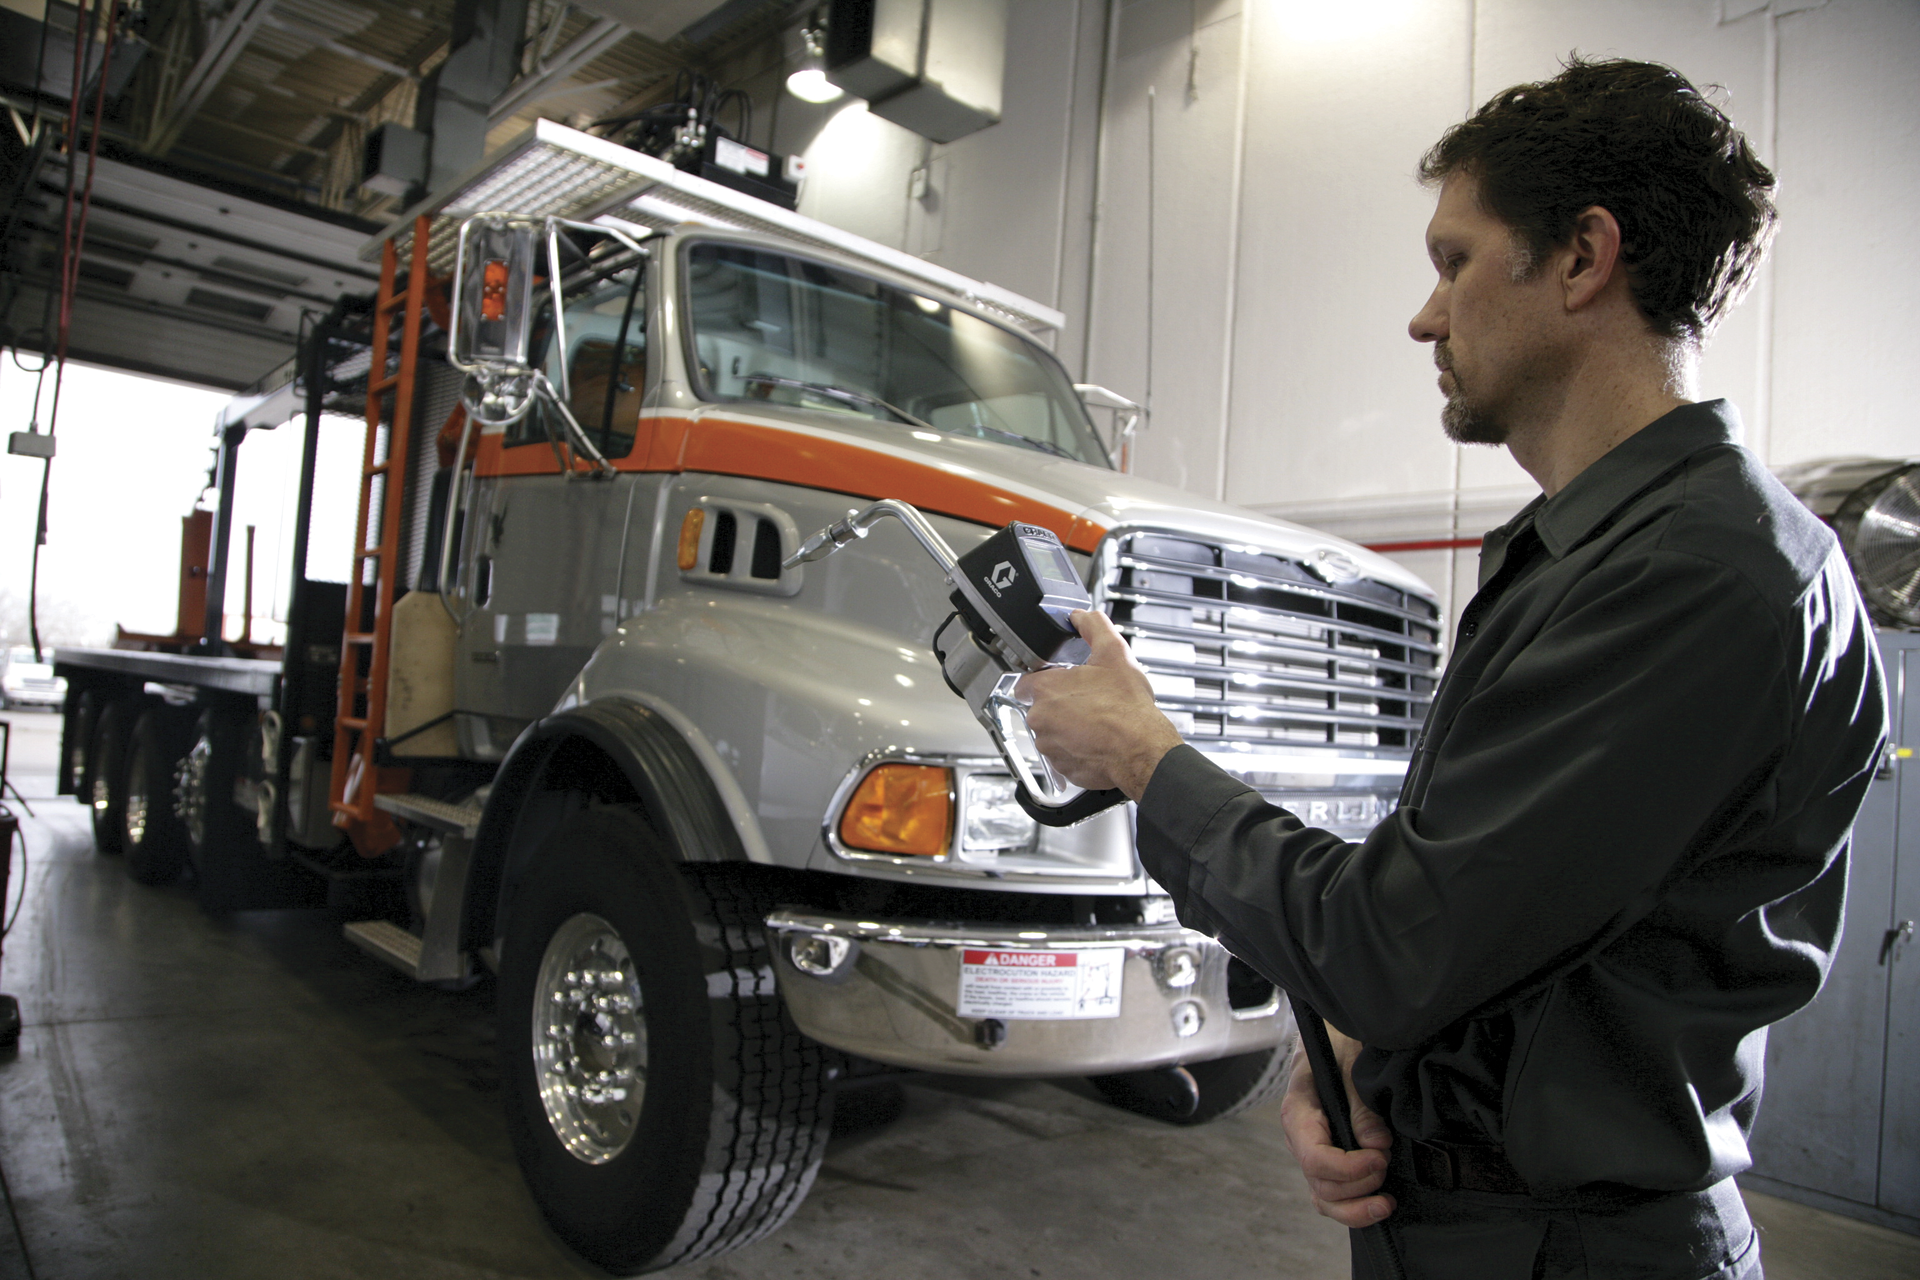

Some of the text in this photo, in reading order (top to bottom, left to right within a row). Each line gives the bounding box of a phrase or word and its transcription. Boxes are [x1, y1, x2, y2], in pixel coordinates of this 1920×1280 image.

[983, 576, 1002, 598] GRACO
[1000, 954, 1056, 966] DANGER
[964, 967, 1038, 976] ELECTROCUTION
